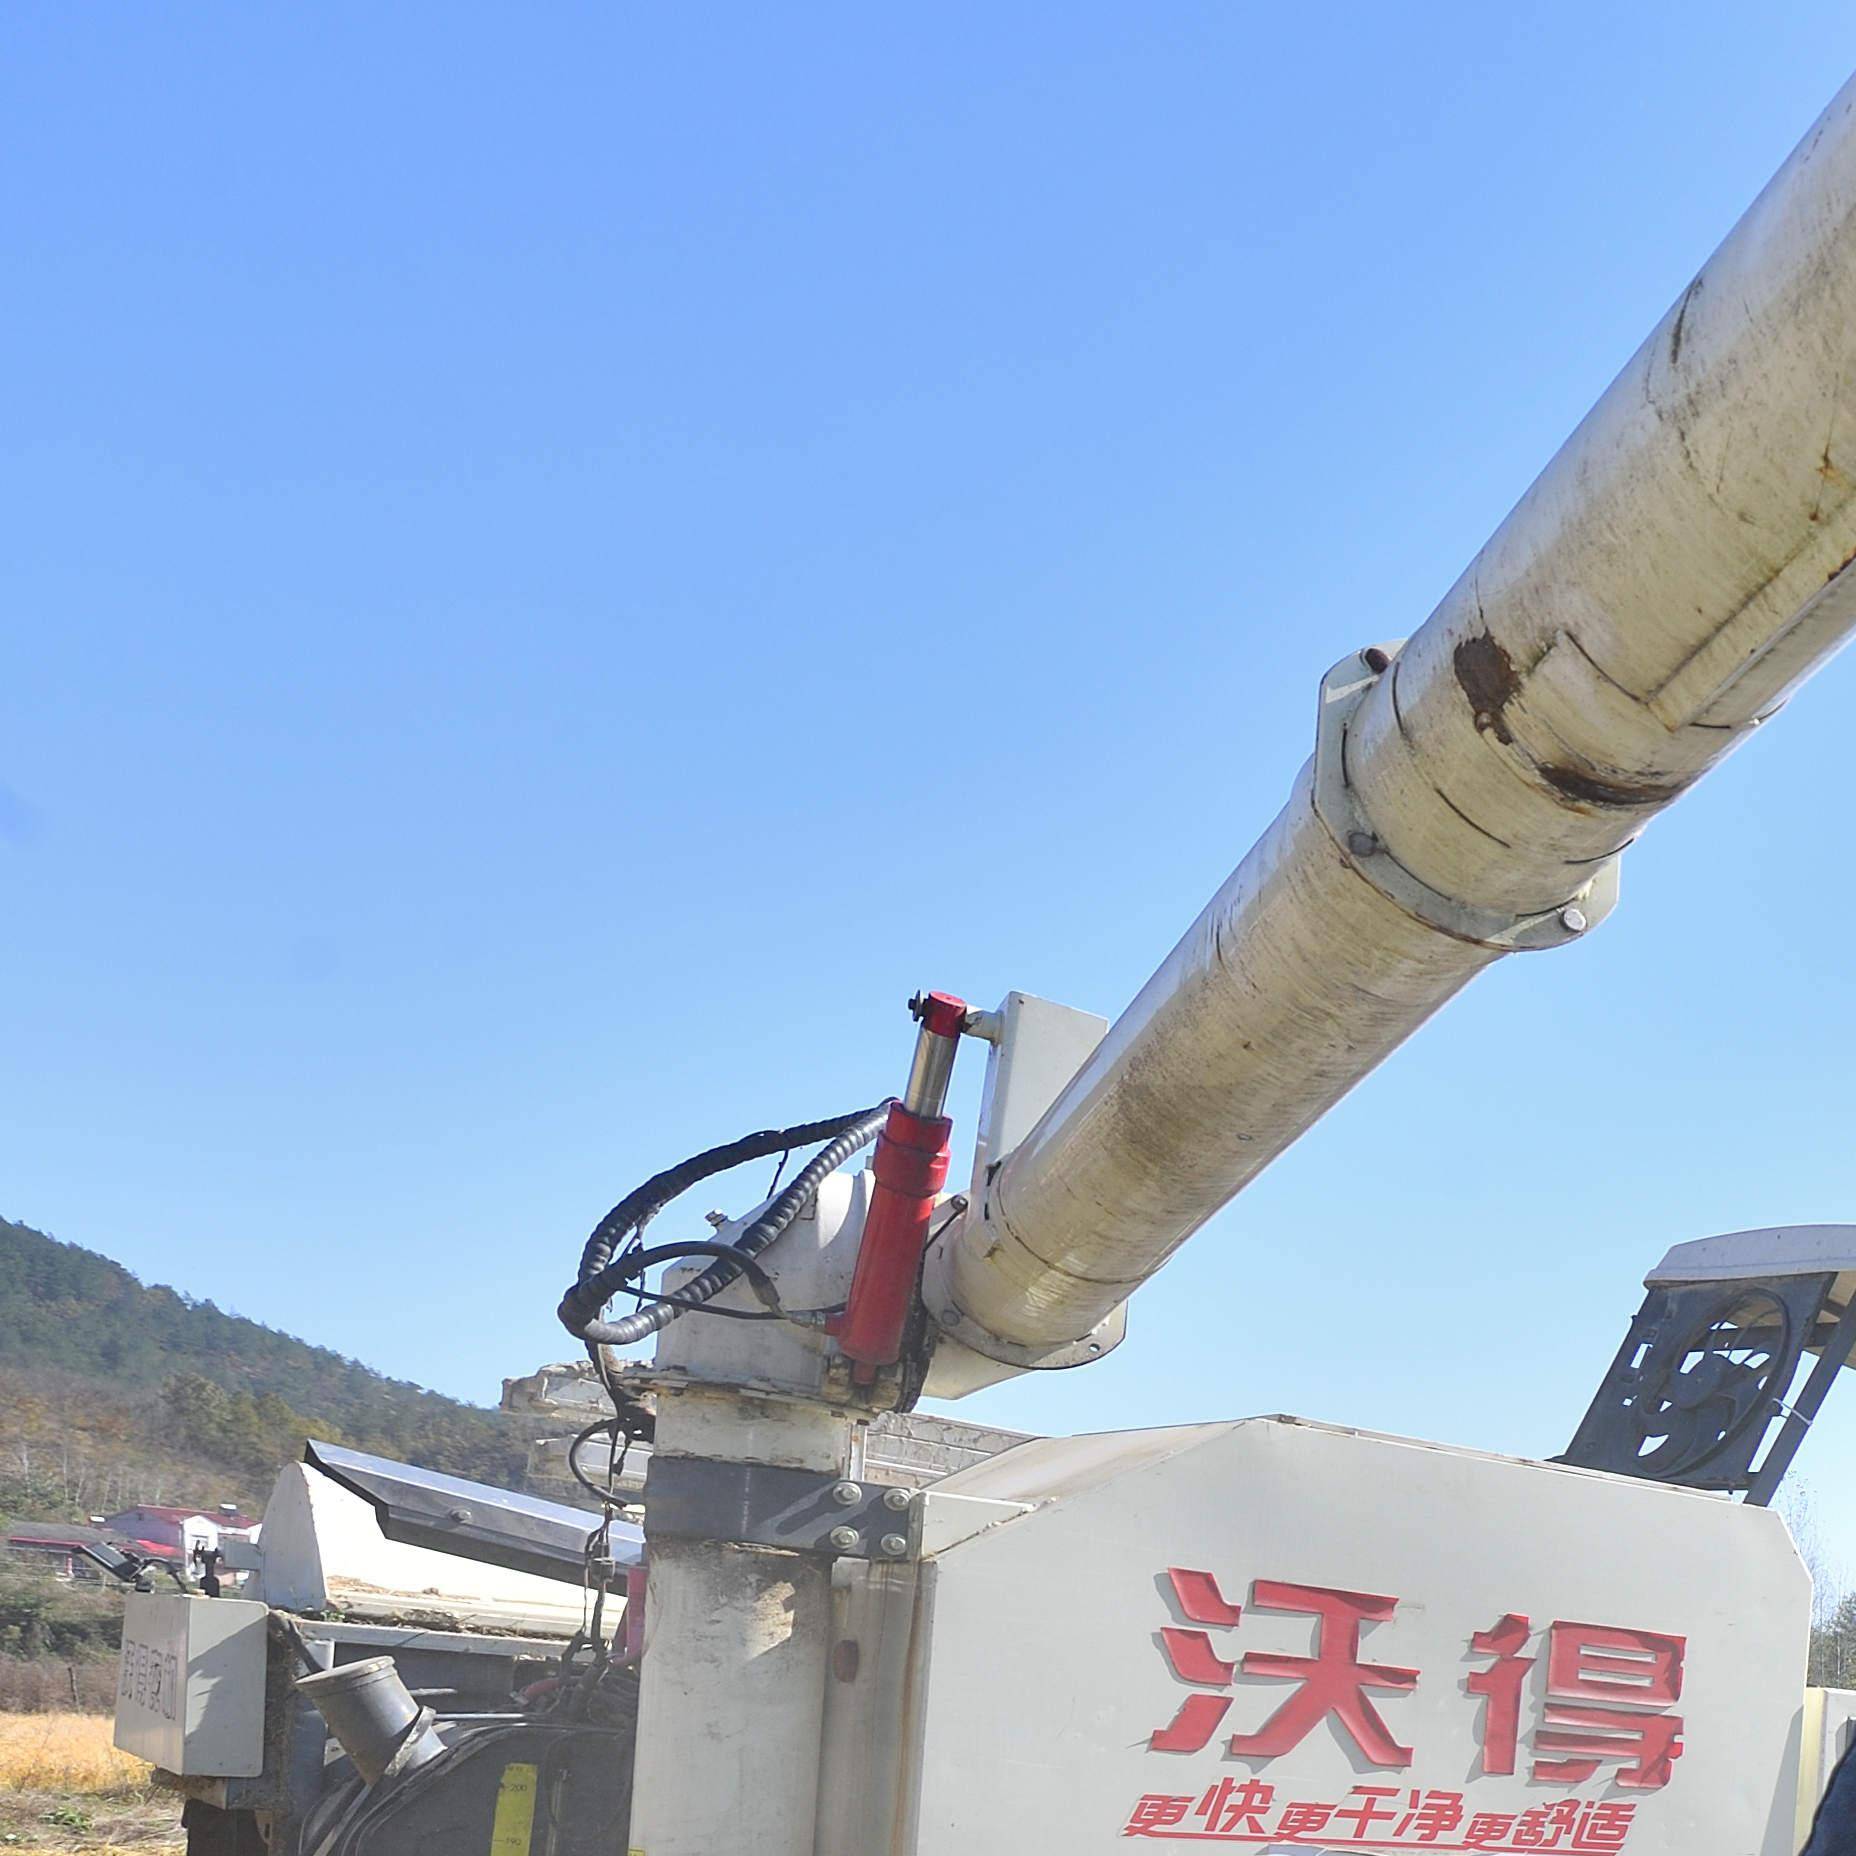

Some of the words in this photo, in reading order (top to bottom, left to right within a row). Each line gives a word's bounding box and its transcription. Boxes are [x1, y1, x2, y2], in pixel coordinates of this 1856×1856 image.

[1147, 1566, 1687, 1789] 沃得
[1126, 1777, 1638, 1853] 更快更干净更舒适
